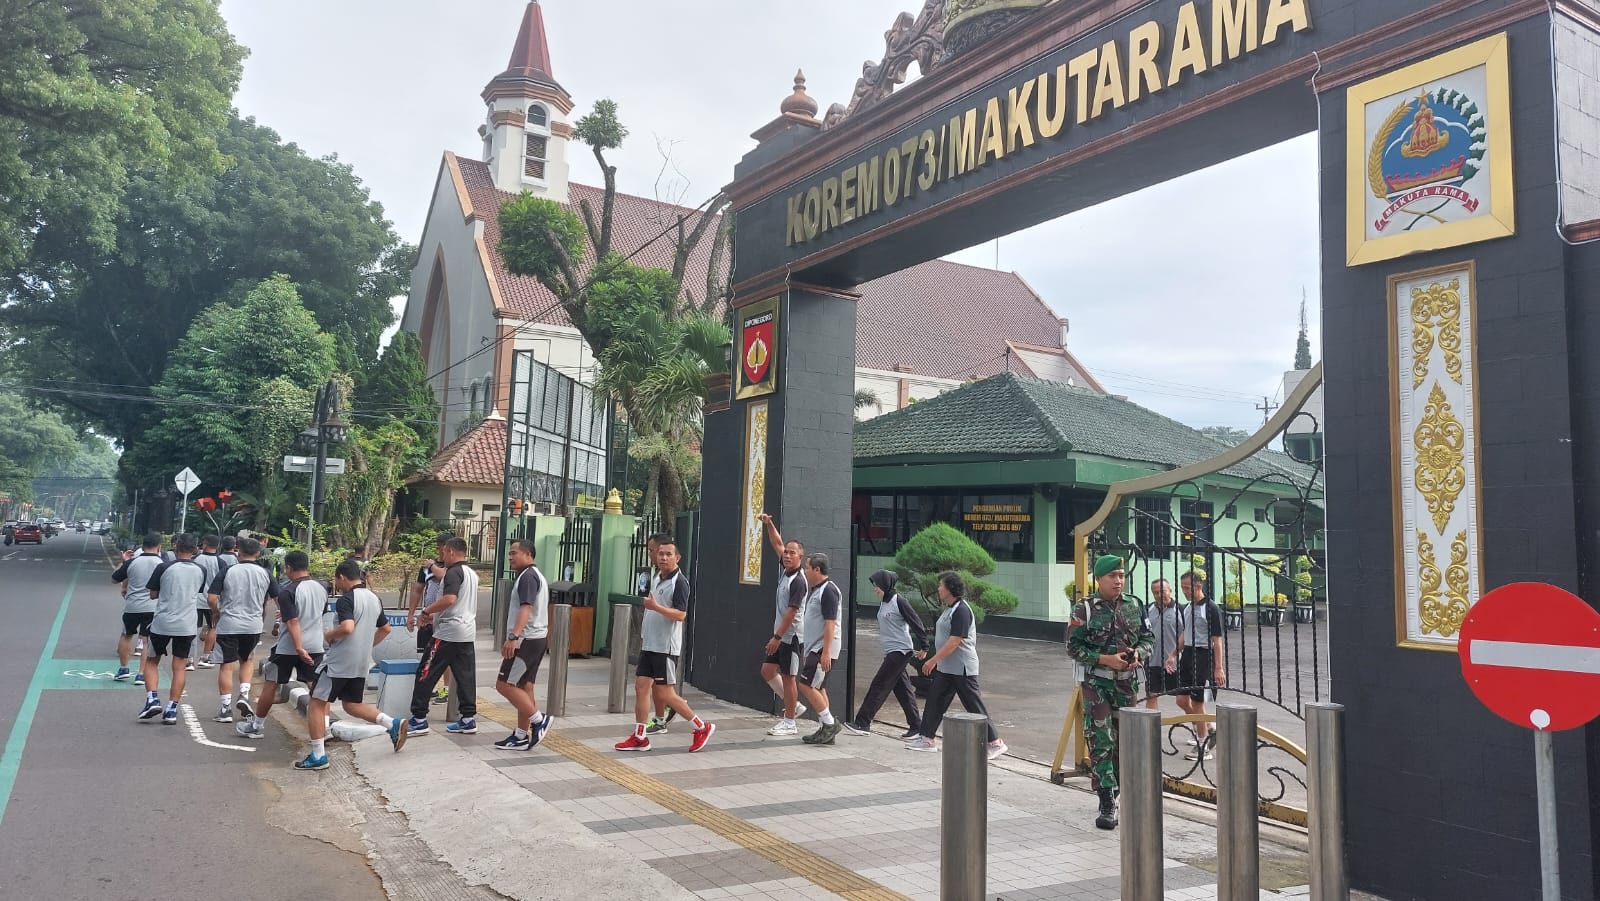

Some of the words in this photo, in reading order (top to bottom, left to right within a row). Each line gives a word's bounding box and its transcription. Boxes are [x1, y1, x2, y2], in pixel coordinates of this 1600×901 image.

[786, 156, 879, 246] KOREM
[883, 0, 1314, 198] 073/MAKUTARAMA
[1385, 189, 1429, 216] MAKUTA
[1434, 186, 1464, 199] RAMA
